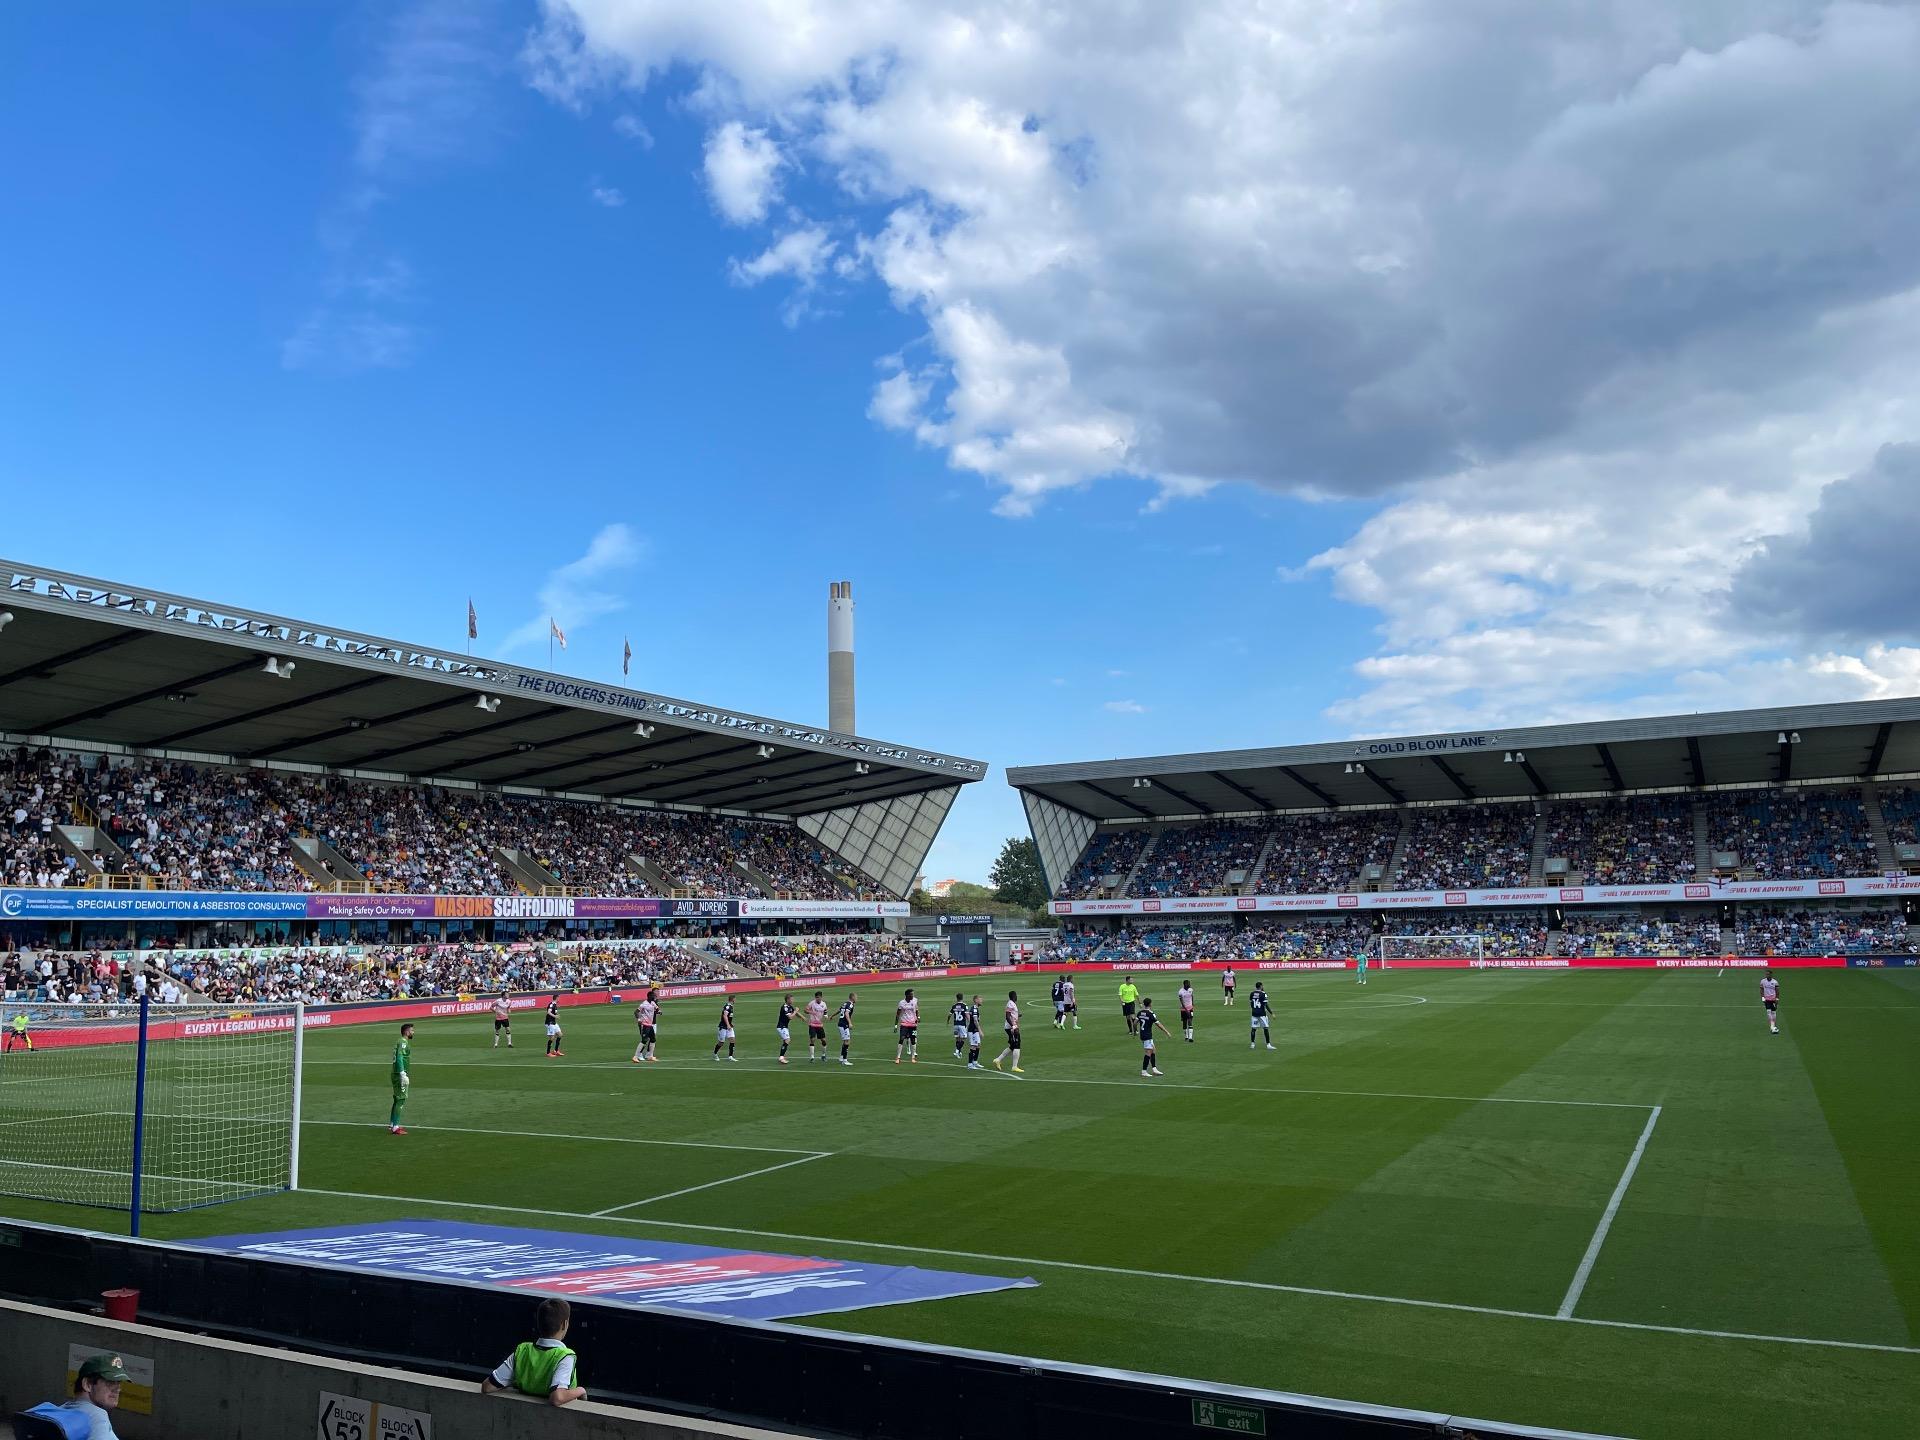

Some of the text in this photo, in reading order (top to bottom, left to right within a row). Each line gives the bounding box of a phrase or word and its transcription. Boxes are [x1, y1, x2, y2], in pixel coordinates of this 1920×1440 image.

[518, 674, 646, 710] THE DOCKERS STAND
[1370, 736, 1486, 754] COLD BLOW LANE
[8, 900, 22, 908] PJF
[76, 900, 306, 910] SPECIALIST DEMOLITION & ASBESTOS CONSULTANCY
[316, 897, 340, 906] Serving
[434, 898, 493, 916] MASONS
[494, 899, 574, 917] SCAFFOLDING
[328, 906, 352, 916] Making
[354, 906, 374, 916] Safety
[391, 906, 415, 916] Priority
[432, 1005, 456, 1014] EVERY
[457, 1003, 482, 1012] LEGEND
[1252, 999, 1261, 1008] 14
[955, 1012, 963, 1021] 16
[185, 1022, 218, 1034] EVERY
[220, 1019, 256, 1032] LEGEND
[258, 1018, 276, 1029] HAS
[277, 1018, 285, 1028] A
[334, 1408, 365, 1424] BLOCK
[1217, 1406, 1258, 1420] Emergency
[382, 1418, 414, 1435] BLOCK
[1228, 1418, 1250, 1430] exit
